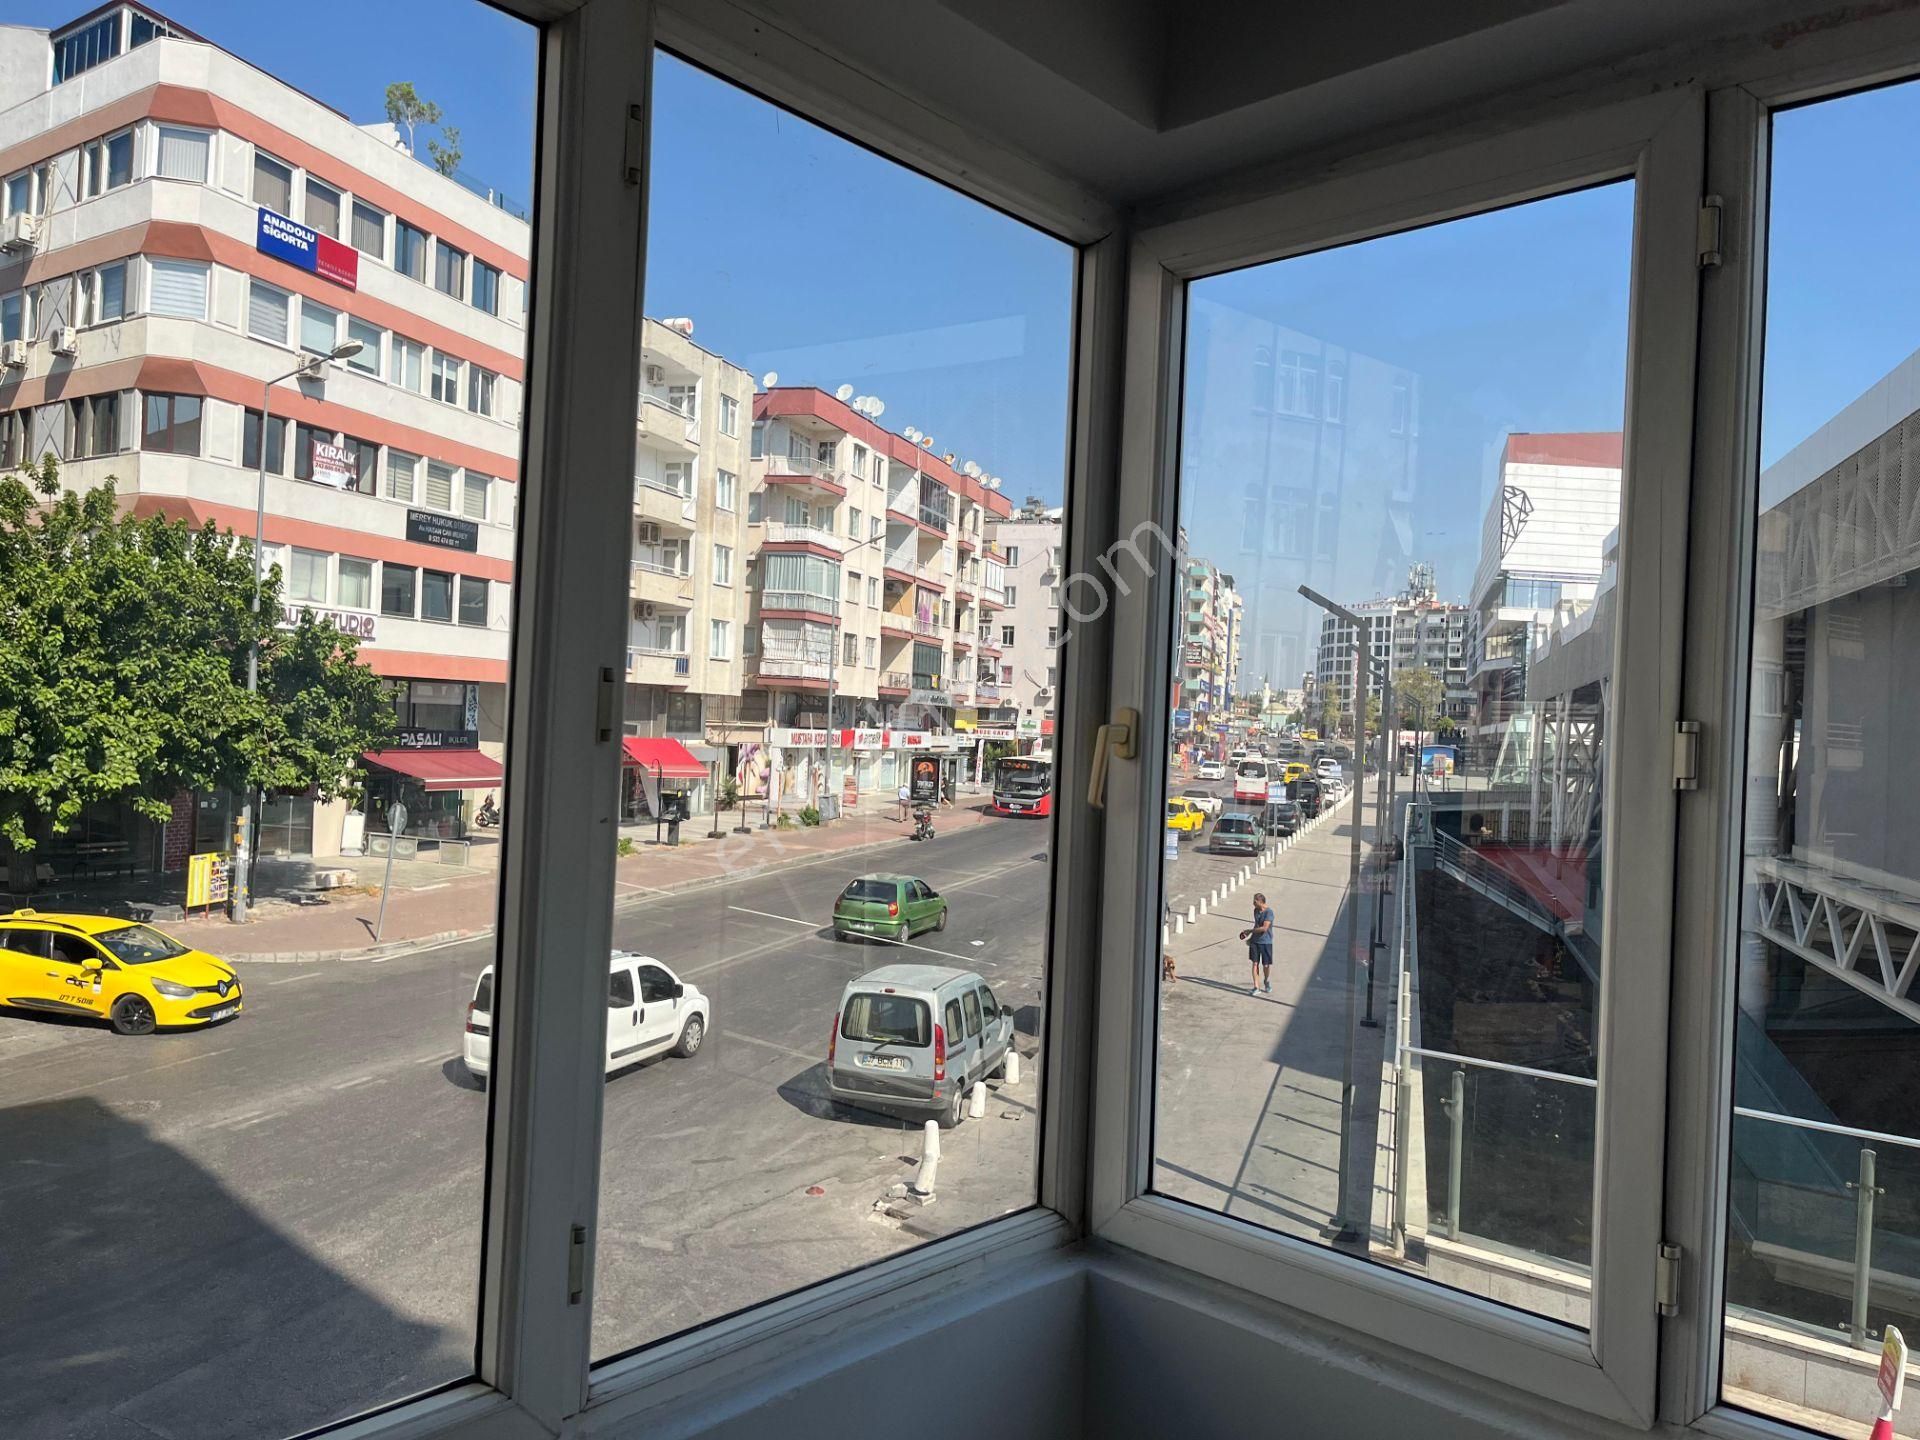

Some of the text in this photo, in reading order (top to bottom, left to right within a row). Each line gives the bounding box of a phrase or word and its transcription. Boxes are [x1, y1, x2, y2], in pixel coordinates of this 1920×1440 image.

[262, 224, 309, 251] SİGORTA
[264, 213, 315, 243] ANADOLU
[316, 442, 356, 466] KİRALIK
[432, 516, 454, 528] HUKUK
[400, 732, 442, 749] PAŞALI
